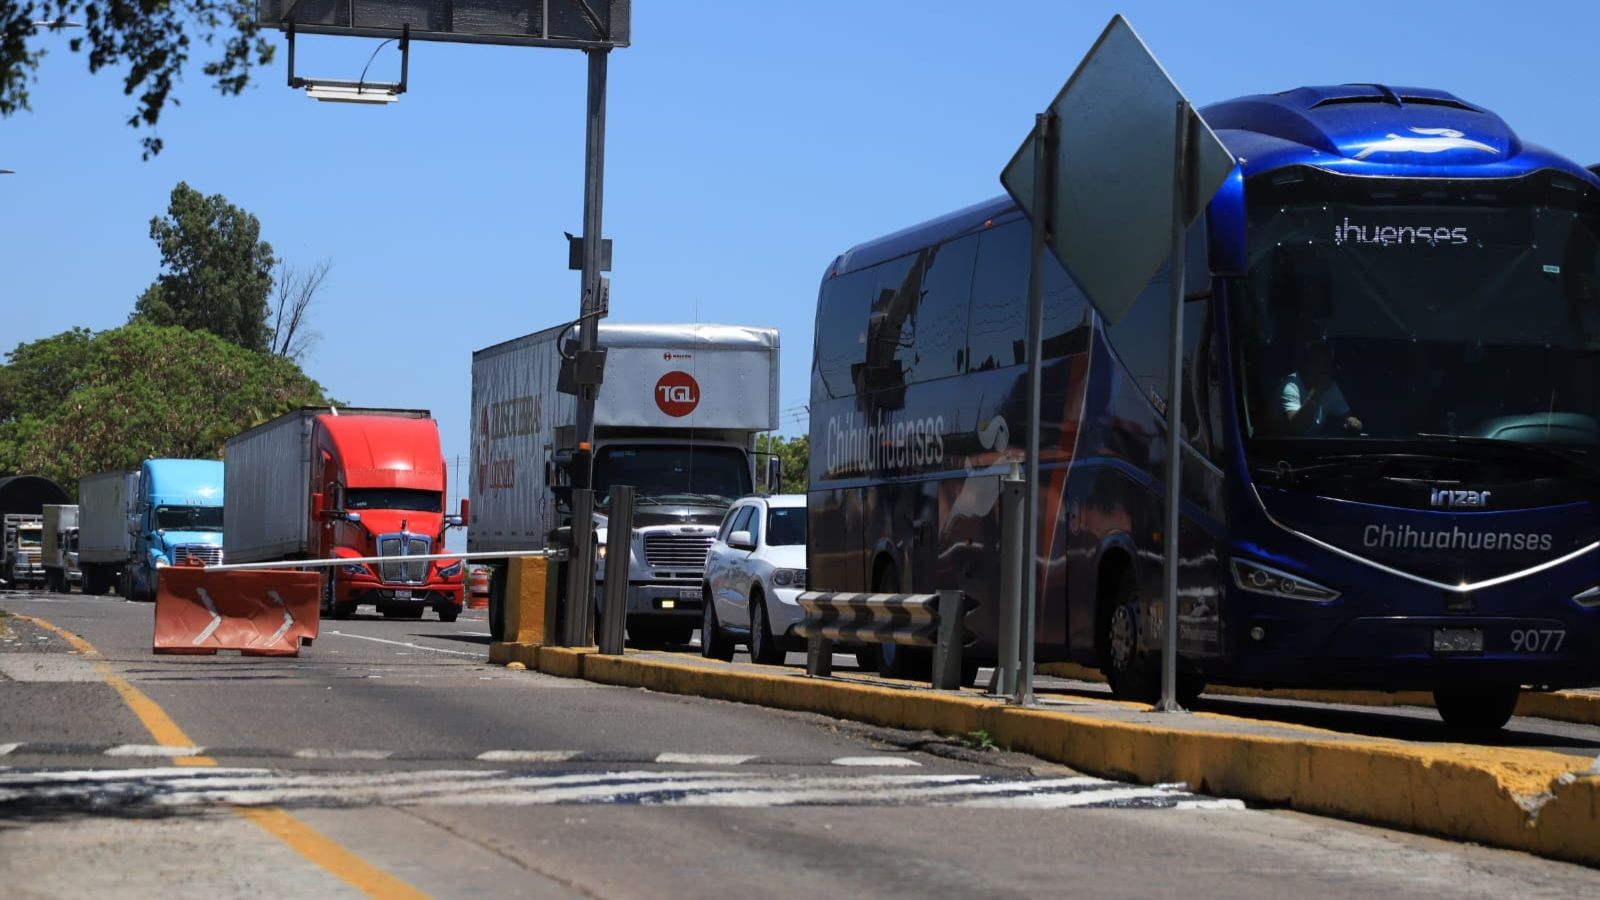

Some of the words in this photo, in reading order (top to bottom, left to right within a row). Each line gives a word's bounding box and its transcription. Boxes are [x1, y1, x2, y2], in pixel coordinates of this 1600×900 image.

[658, 386, 696, 403] TGL
[827, 407, 944, 474] Chihuahuenses
[1363, 524, 1553, 551] Chihuahuenses
[1510, 629, 1566, 652] 9077
